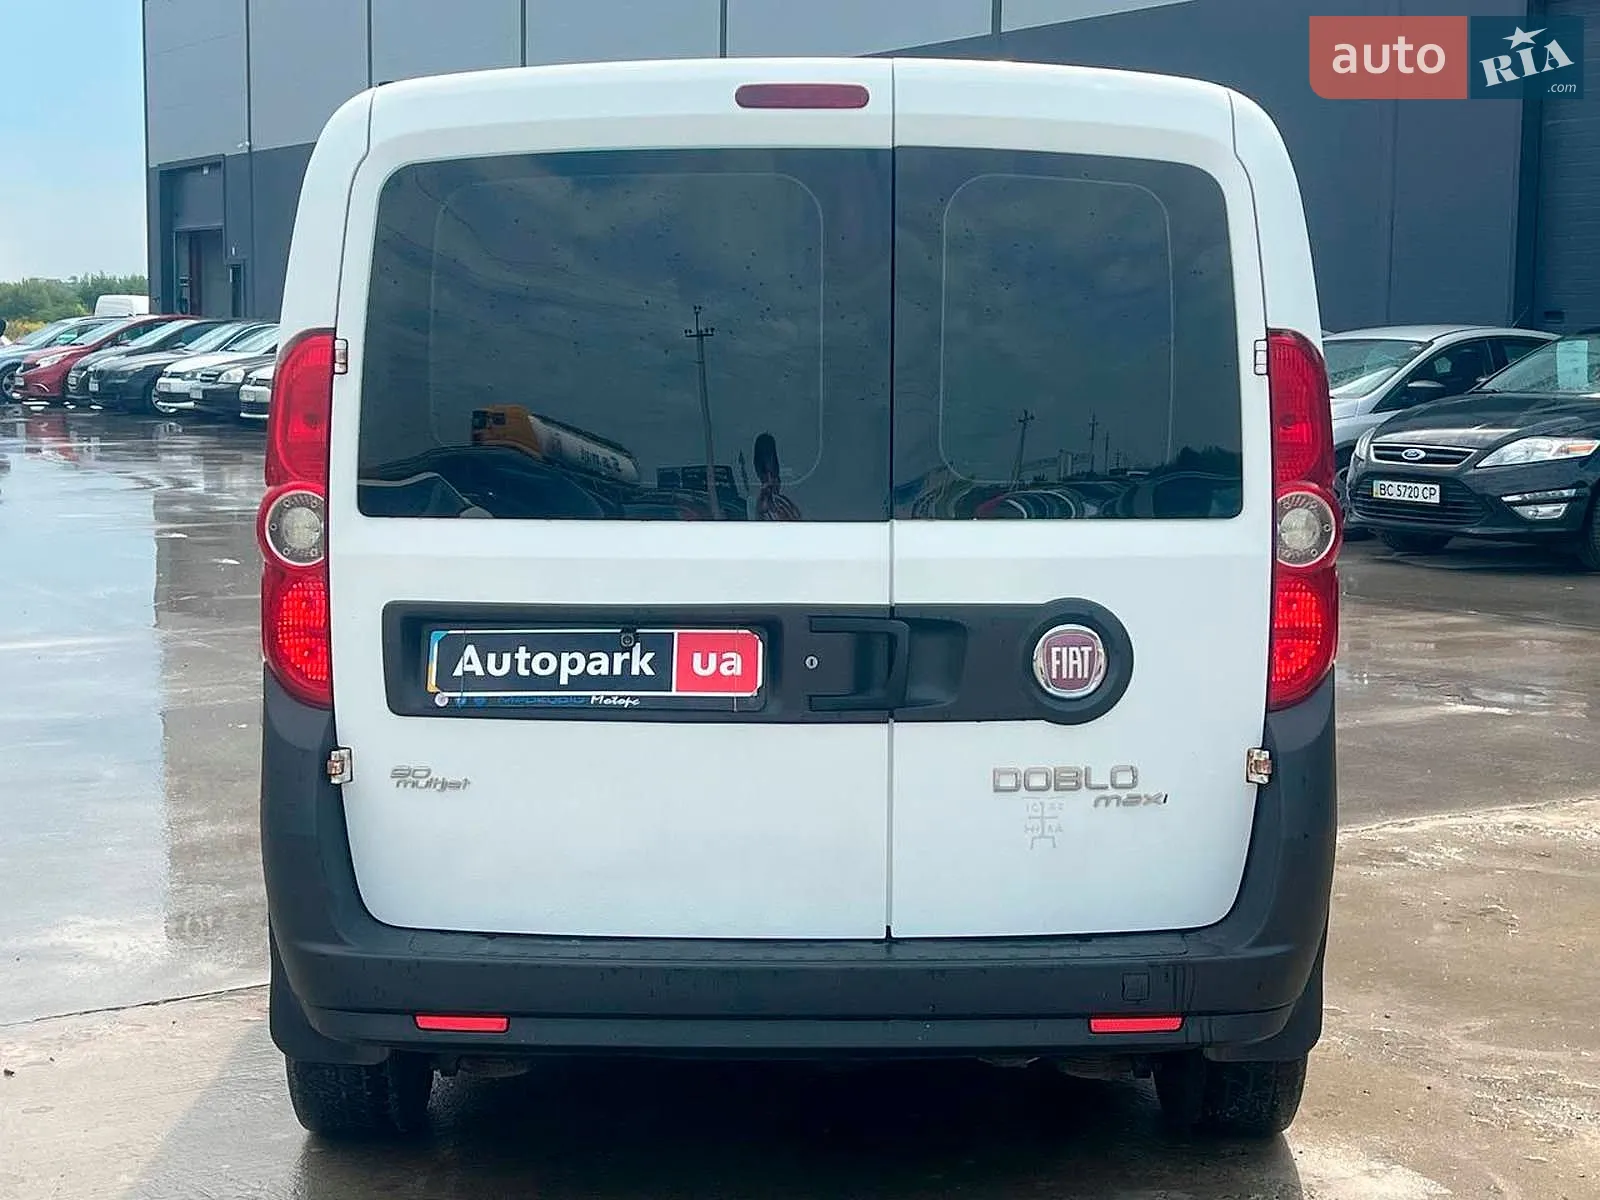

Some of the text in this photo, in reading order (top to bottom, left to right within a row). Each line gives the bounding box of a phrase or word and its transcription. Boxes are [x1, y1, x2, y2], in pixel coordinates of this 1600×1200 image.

[1380, 483, 1437, 500] BC 5720 CP
[452, 642, 742, 685] Autopark ua
[1051, 646, 1092, 679] FIAT
[992, 764, 1138, 792] DOBLO
